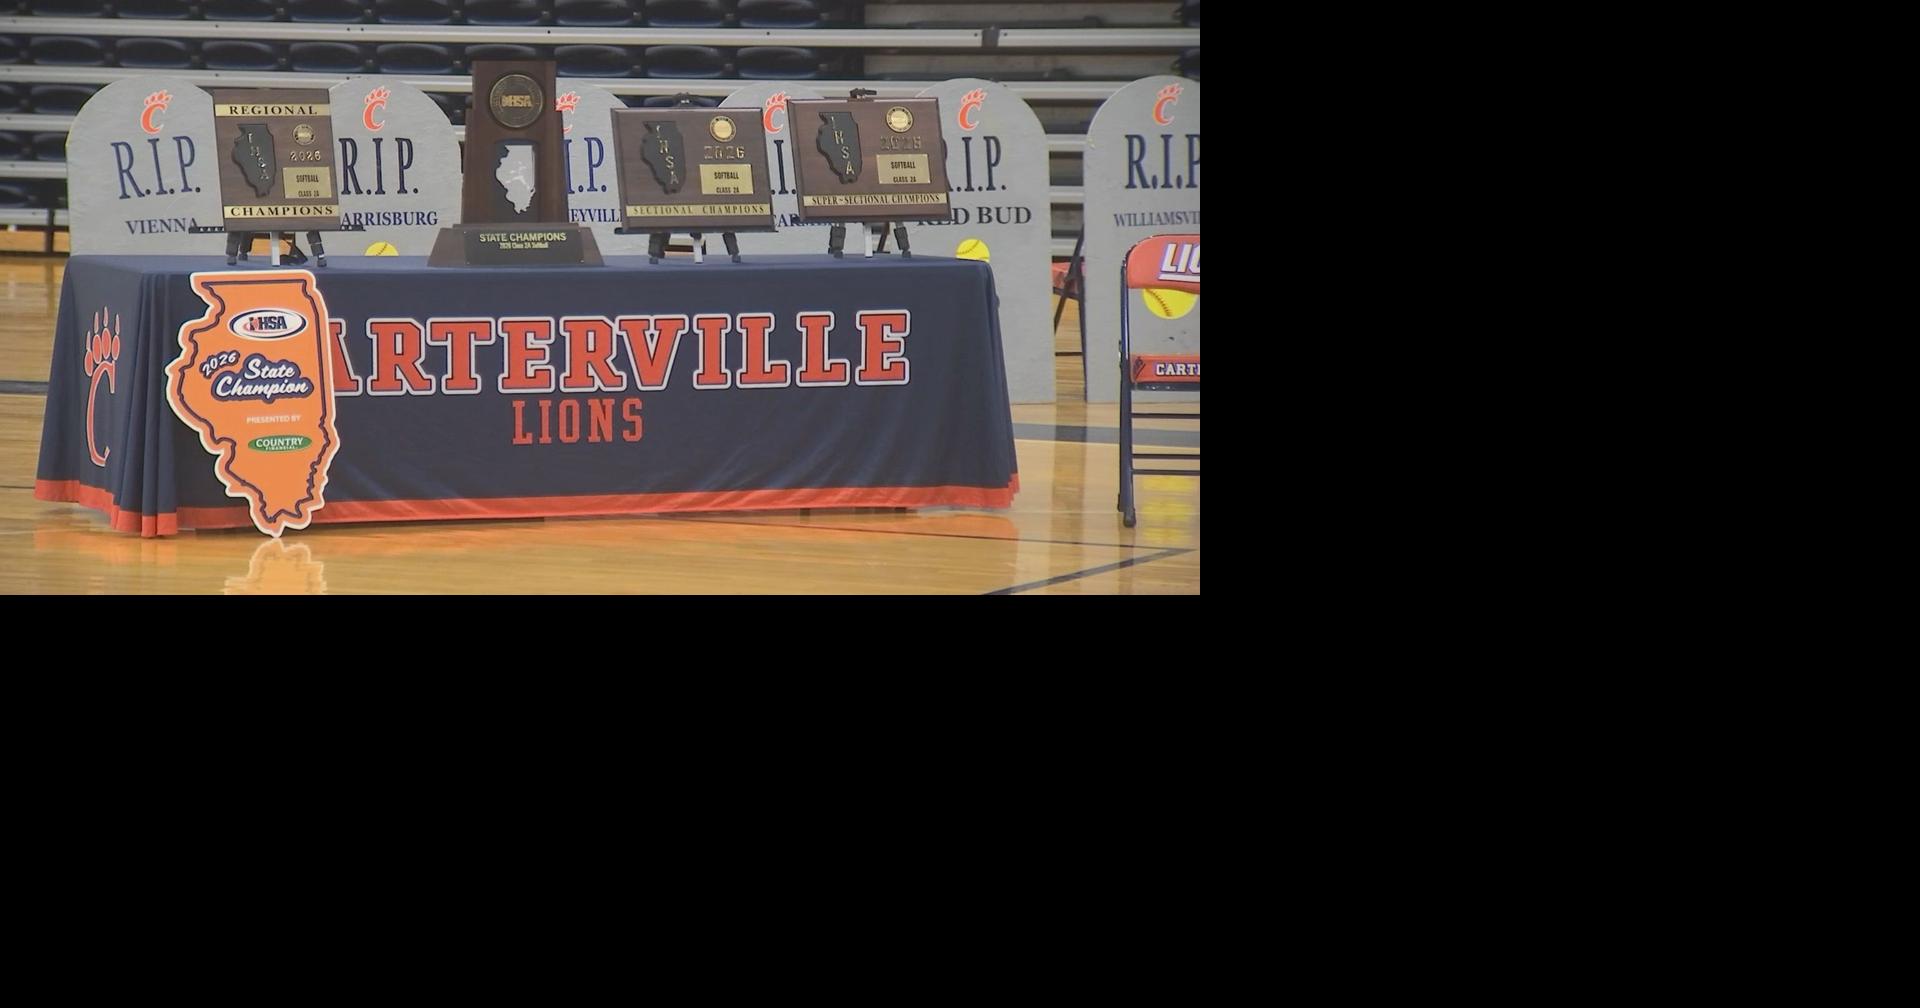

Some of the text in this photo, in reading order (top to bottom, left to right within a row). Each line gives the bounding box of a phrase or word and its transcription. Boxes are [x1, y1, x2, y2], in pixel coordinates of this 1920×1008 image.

[229, 105, 318, 115] REGIONAL
[289, 150, 321, 162] 2026
[704, 145, 745, 159] 2026
[111, 136, 201, 200] R.I.P.
[891, 161, 916, 170] SOFTBALL
[942, 136, 1006, 192] .I.P.
[713, 171, 740, 180] SOFTBALL
[891, 194, 941, 204] CHAMPIONS
[230, 206, 333, 216] CHAMPIONS
[633, 204, 765, 216] SECTIONAL CHAMPIONS
[977, 206, 1032, 225] BUD
[340, 210, 439, 226] ARRISBURG
[1113, 211, 1200, 227] WILLIAMSVI
[479, 231, 568, 242] STATE CHAMPIONS
[202, 351, 237, 377] 2026
[244, 358, 295, 380] State
[1156, 363, 1200, 376] CART
[215, 375, 309, 399] Champion
[246, 414, 301, 424] PRESENTED BY
[512, 397, 645, 446] LIONS
[255, 437, 304, 448] COUNTRY
